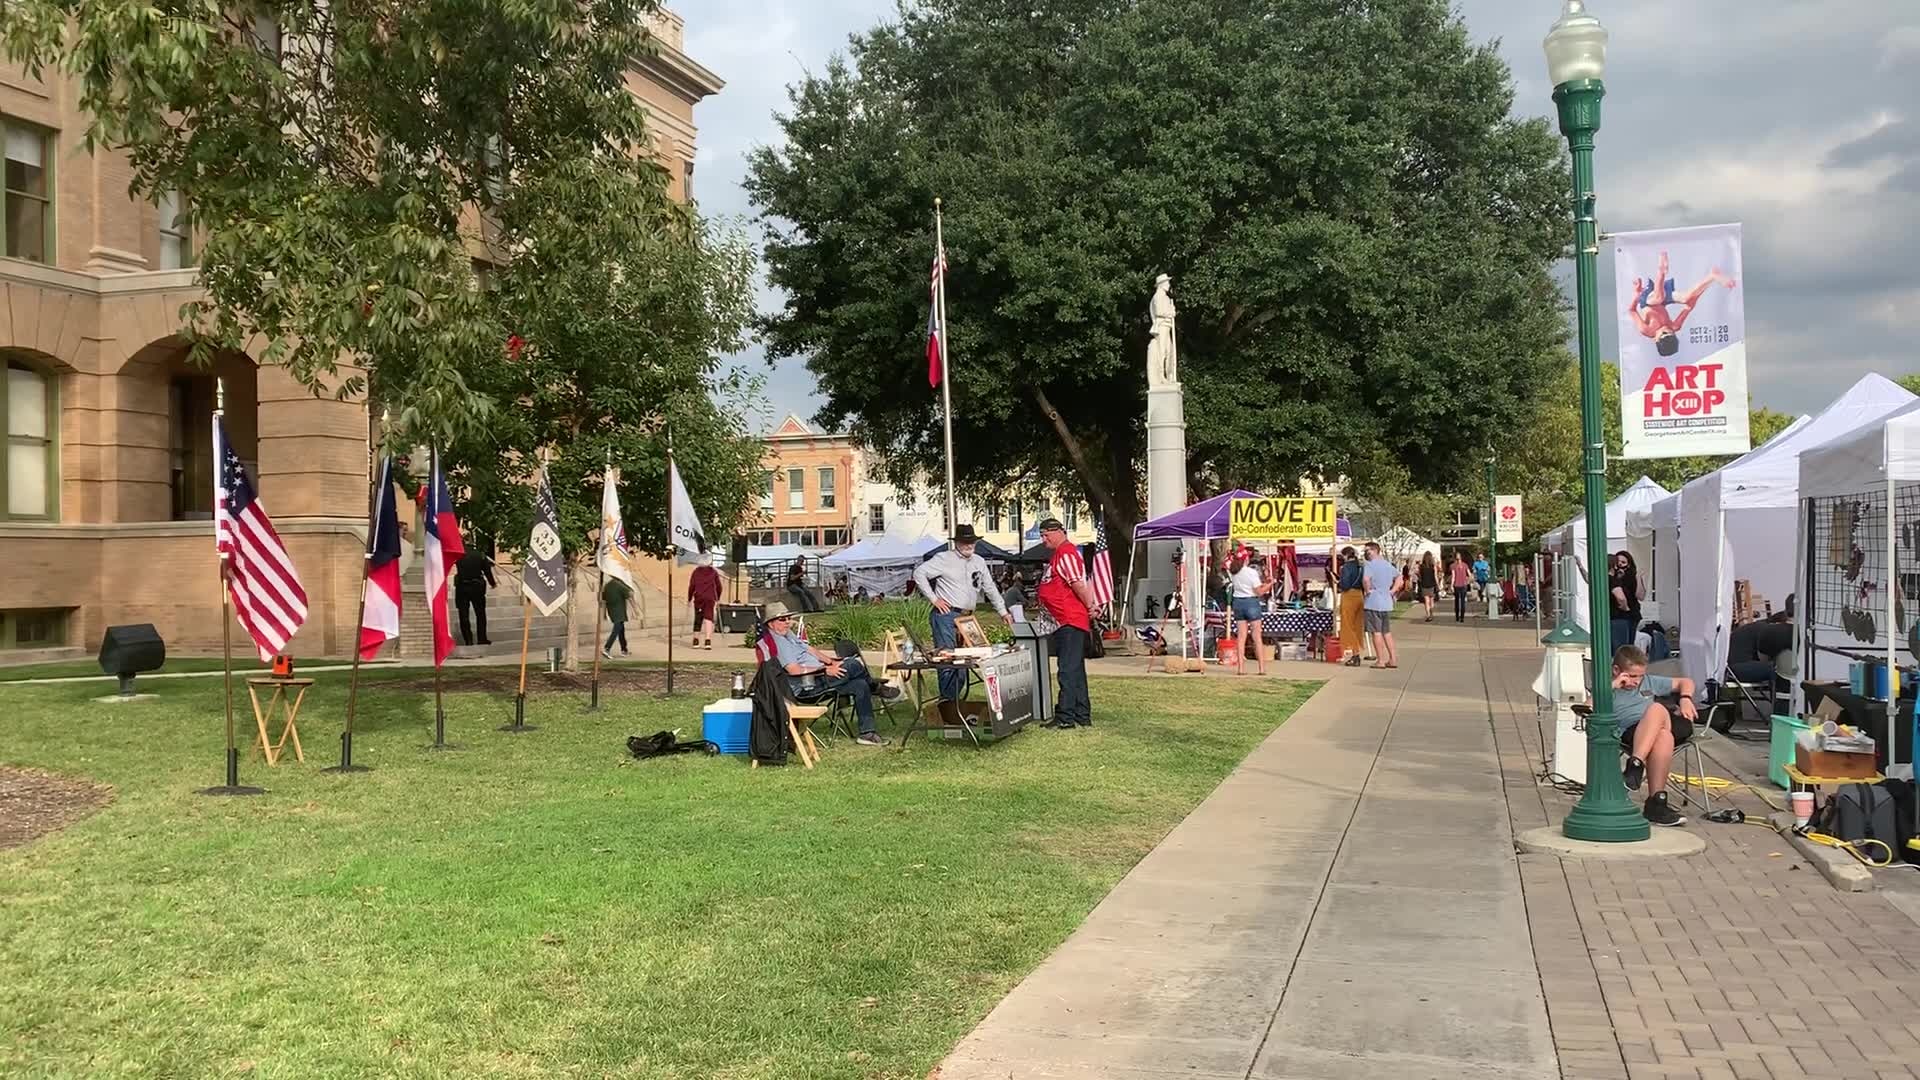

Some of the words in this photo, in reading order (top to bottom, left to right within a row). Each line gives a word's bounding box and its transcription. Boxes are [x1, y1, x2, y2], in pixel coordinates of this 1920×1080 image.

[1690, 327, 1702, 335] OCT
[1718, 325, 1729, 334] 20
[1690, 336, 1702, 344] OCT
[1703, 335, 1712, 343] 31
[1718, 334, 1729, 343] 20
[1643, 364, 1723, 391] ART
[1644, 390, 1725, 417] HOP
[1675, 397, 1699, 410] XIII
[1234, 500, 1303, 523] MOVE
[1311, 500, 1333, 522] IT
[1232, 524, 1303, 534] De-Confederate
[1305, 523, 1334, 533] Texas
[539, 531, 555, 546] 33
